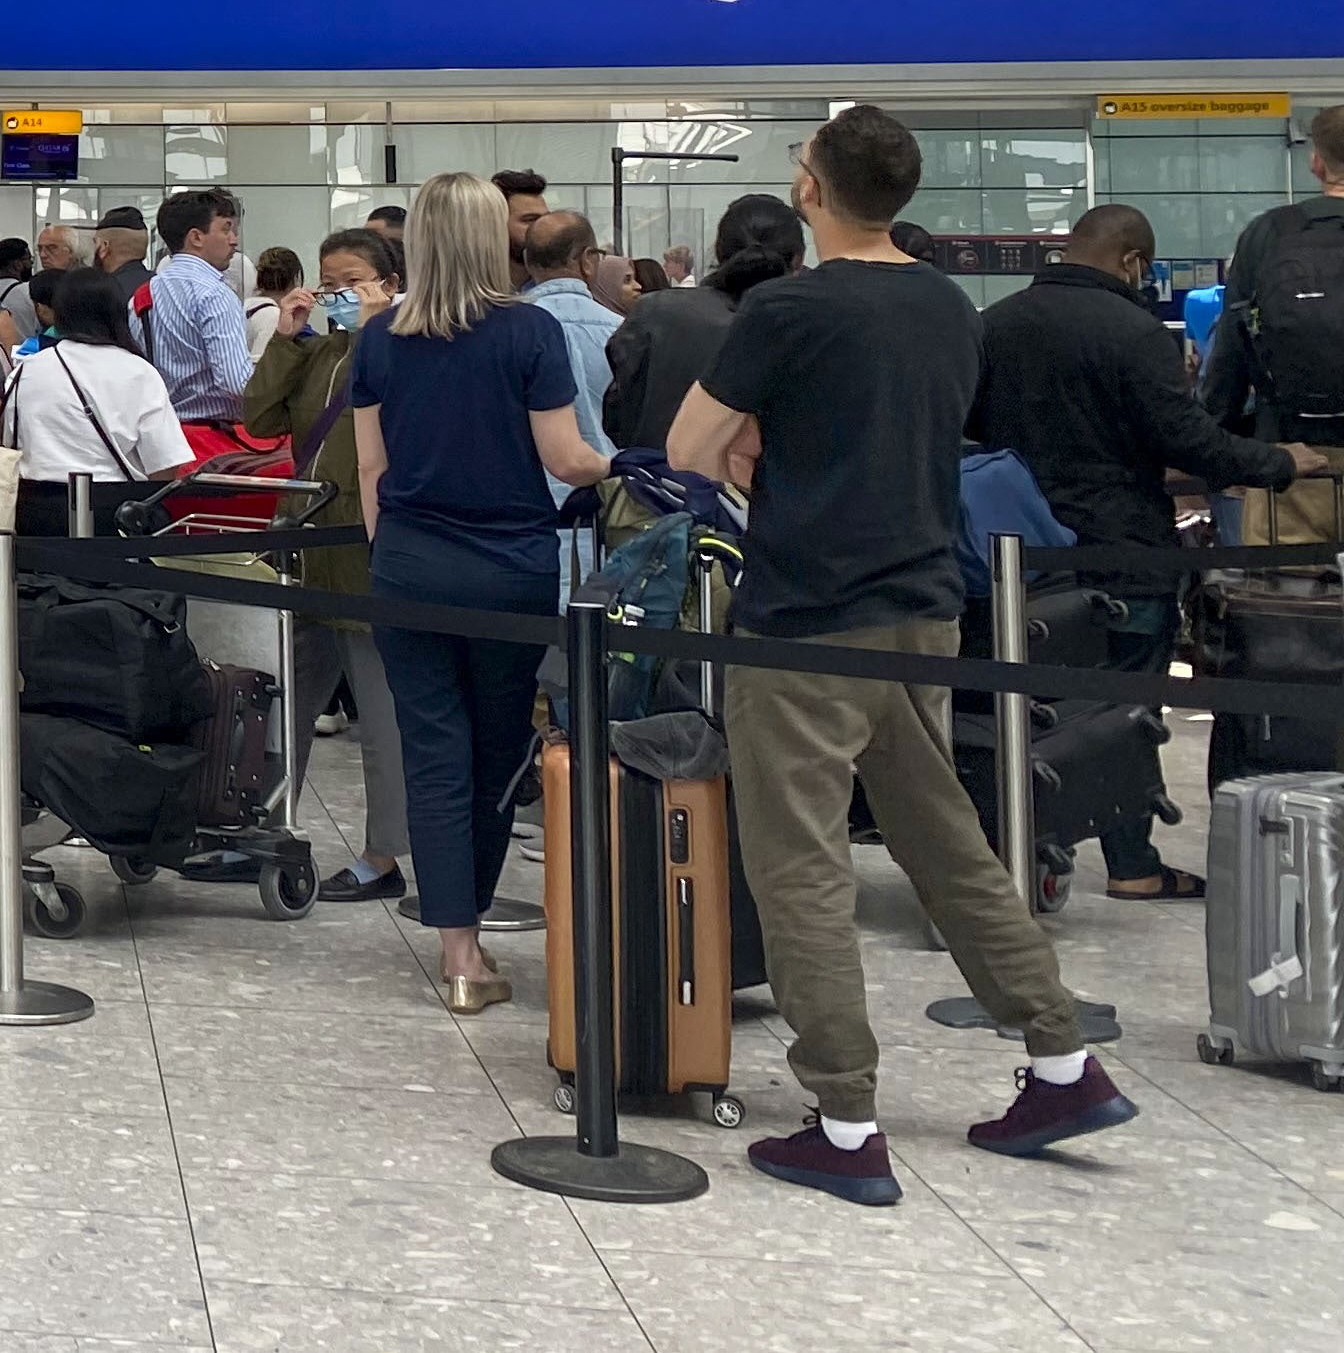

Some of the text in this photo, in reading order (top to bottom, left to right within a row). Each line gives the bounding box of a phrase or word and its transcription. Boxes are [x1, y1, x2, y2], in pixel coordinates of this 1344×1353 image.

[1121, 100, 1270, 114] A15 oversize baggage
[22, 118, 42, 127] A14
